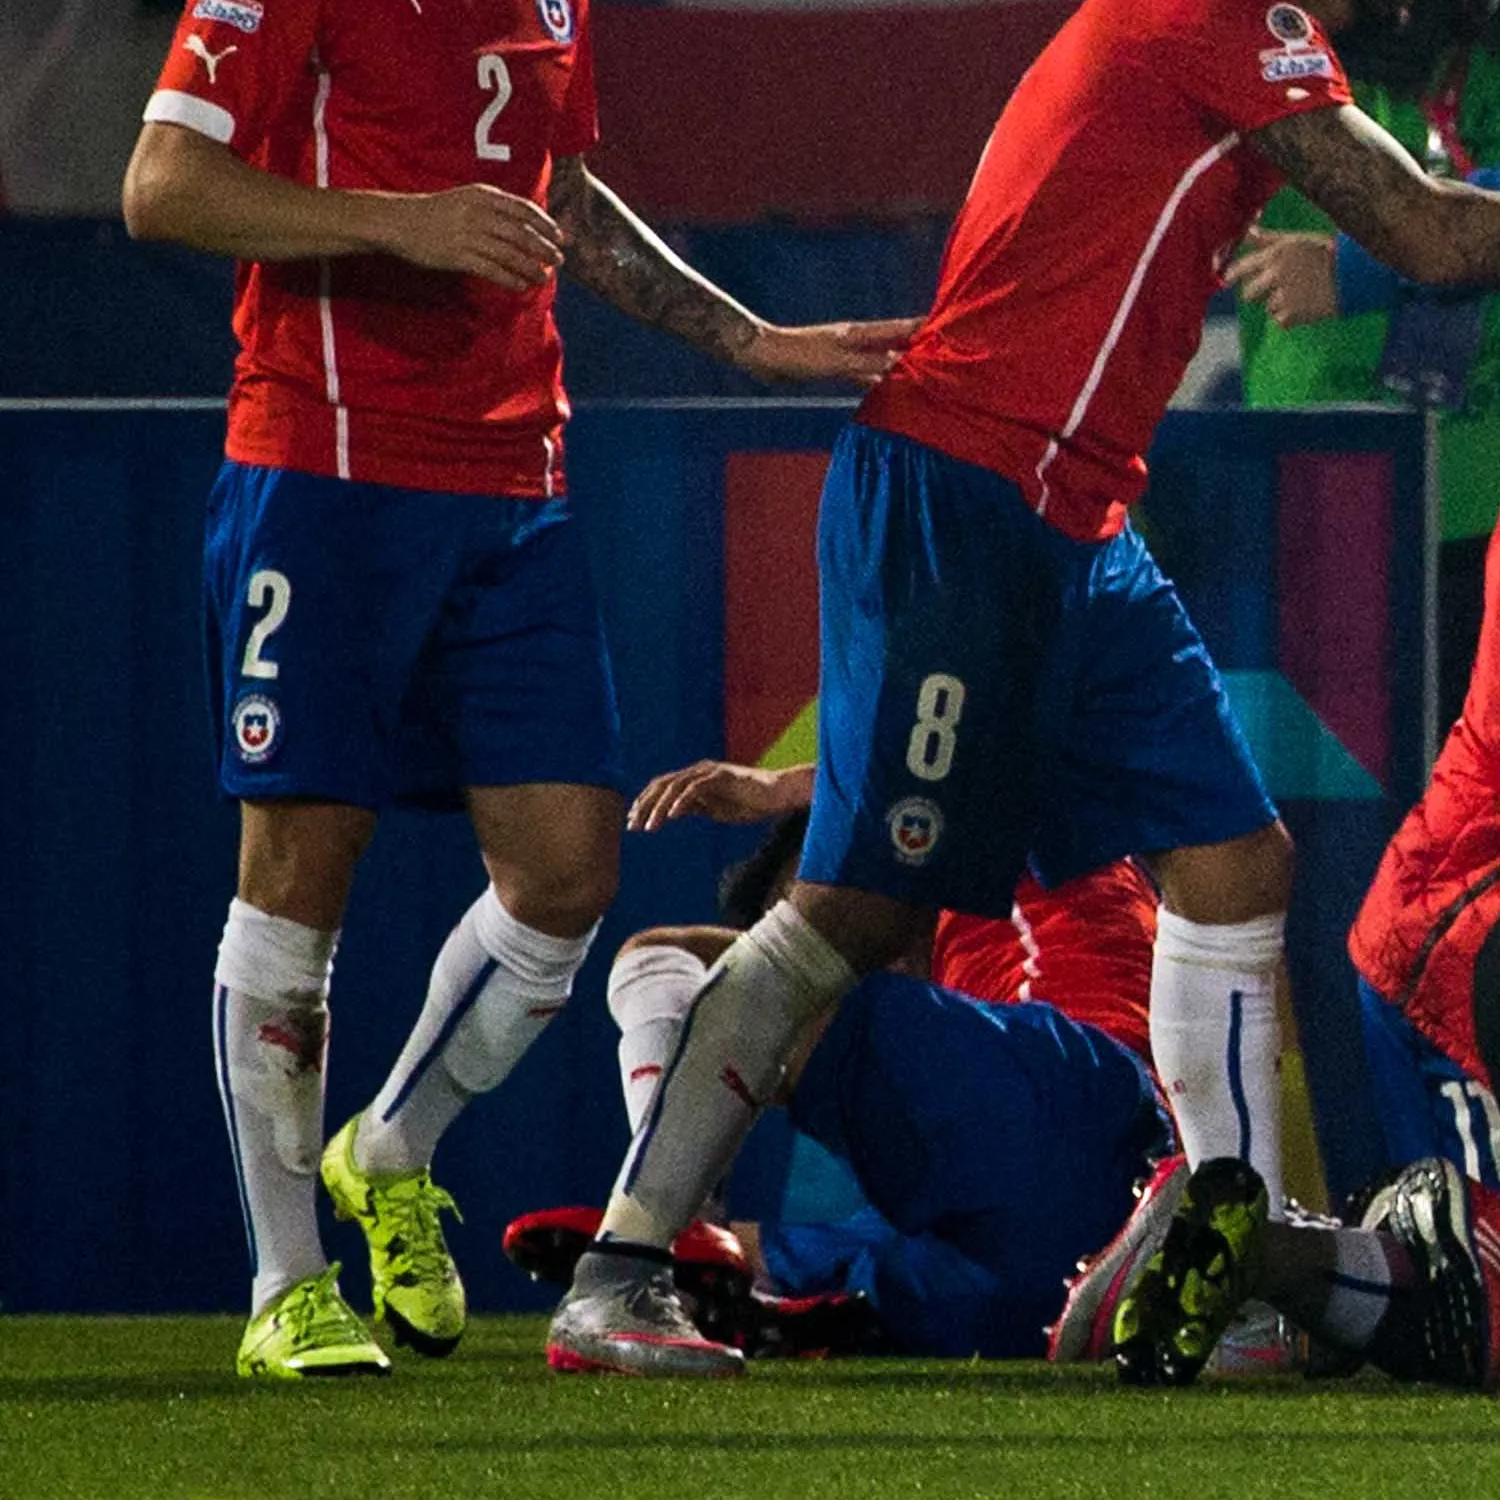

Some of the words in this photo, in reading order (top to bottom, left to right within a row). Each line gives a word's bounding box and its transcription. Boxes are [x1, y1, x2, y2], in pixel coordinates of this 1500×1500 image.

[475, 52, 514, 162] 2
[240, 569, 293, 682] 2
[905, 671, 967, 782] 8
